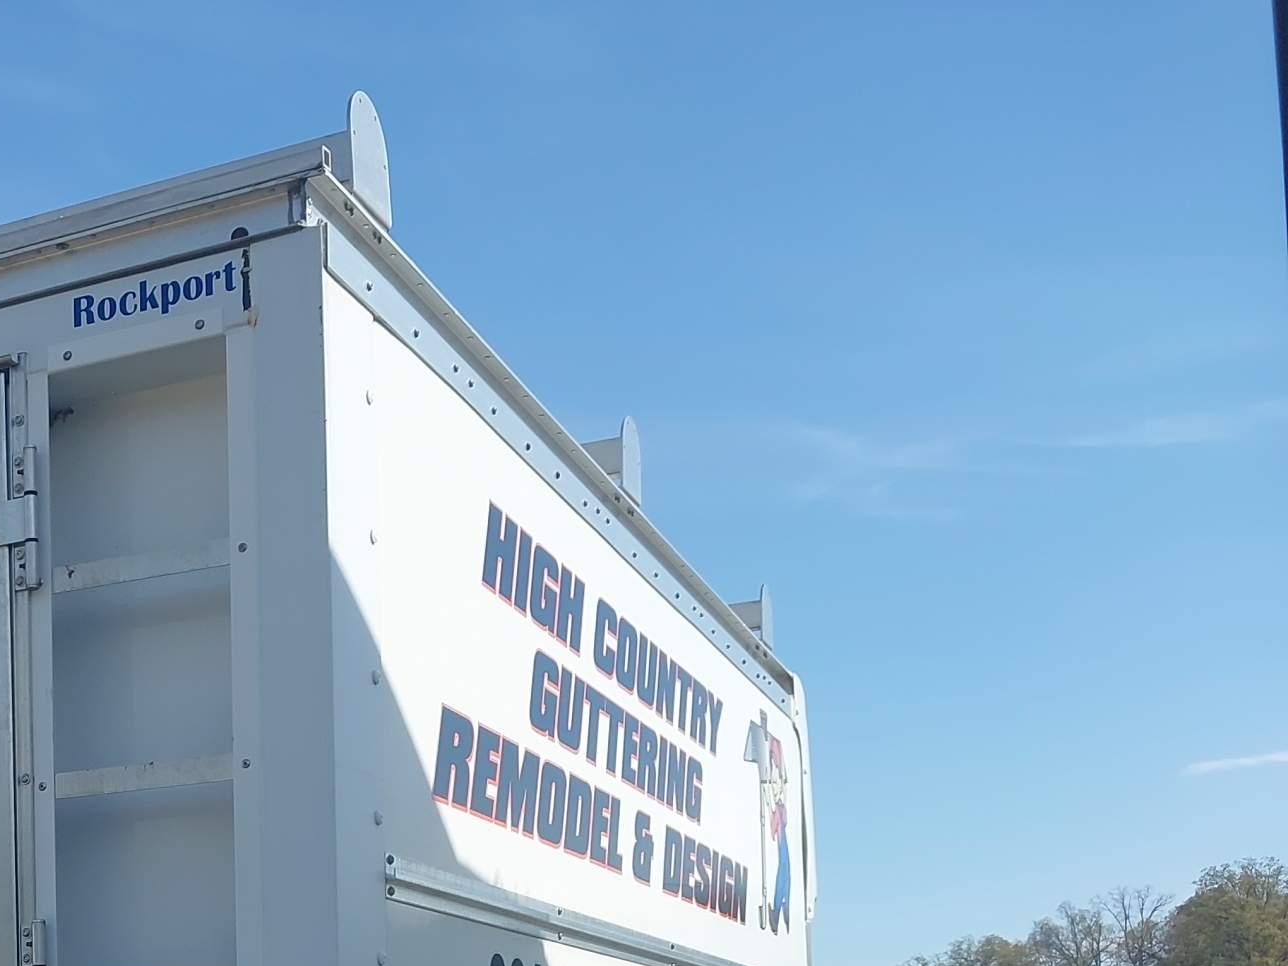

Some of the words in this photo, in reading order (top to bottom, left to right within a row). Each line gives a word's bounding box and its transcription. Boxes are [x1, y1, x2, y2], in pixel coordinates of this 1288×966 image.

[73, 260, 238, 329] Rockport
[481, 498, 586, 657] HIGH
[593, 597, 724, 757] COUNTRY
[431, 702, 623, 874] REMODEL
[631, 809, 655, 887] &
[662, 824, 748, 925] DESIGN
[529, 647, 704, 826] GUTTERING
